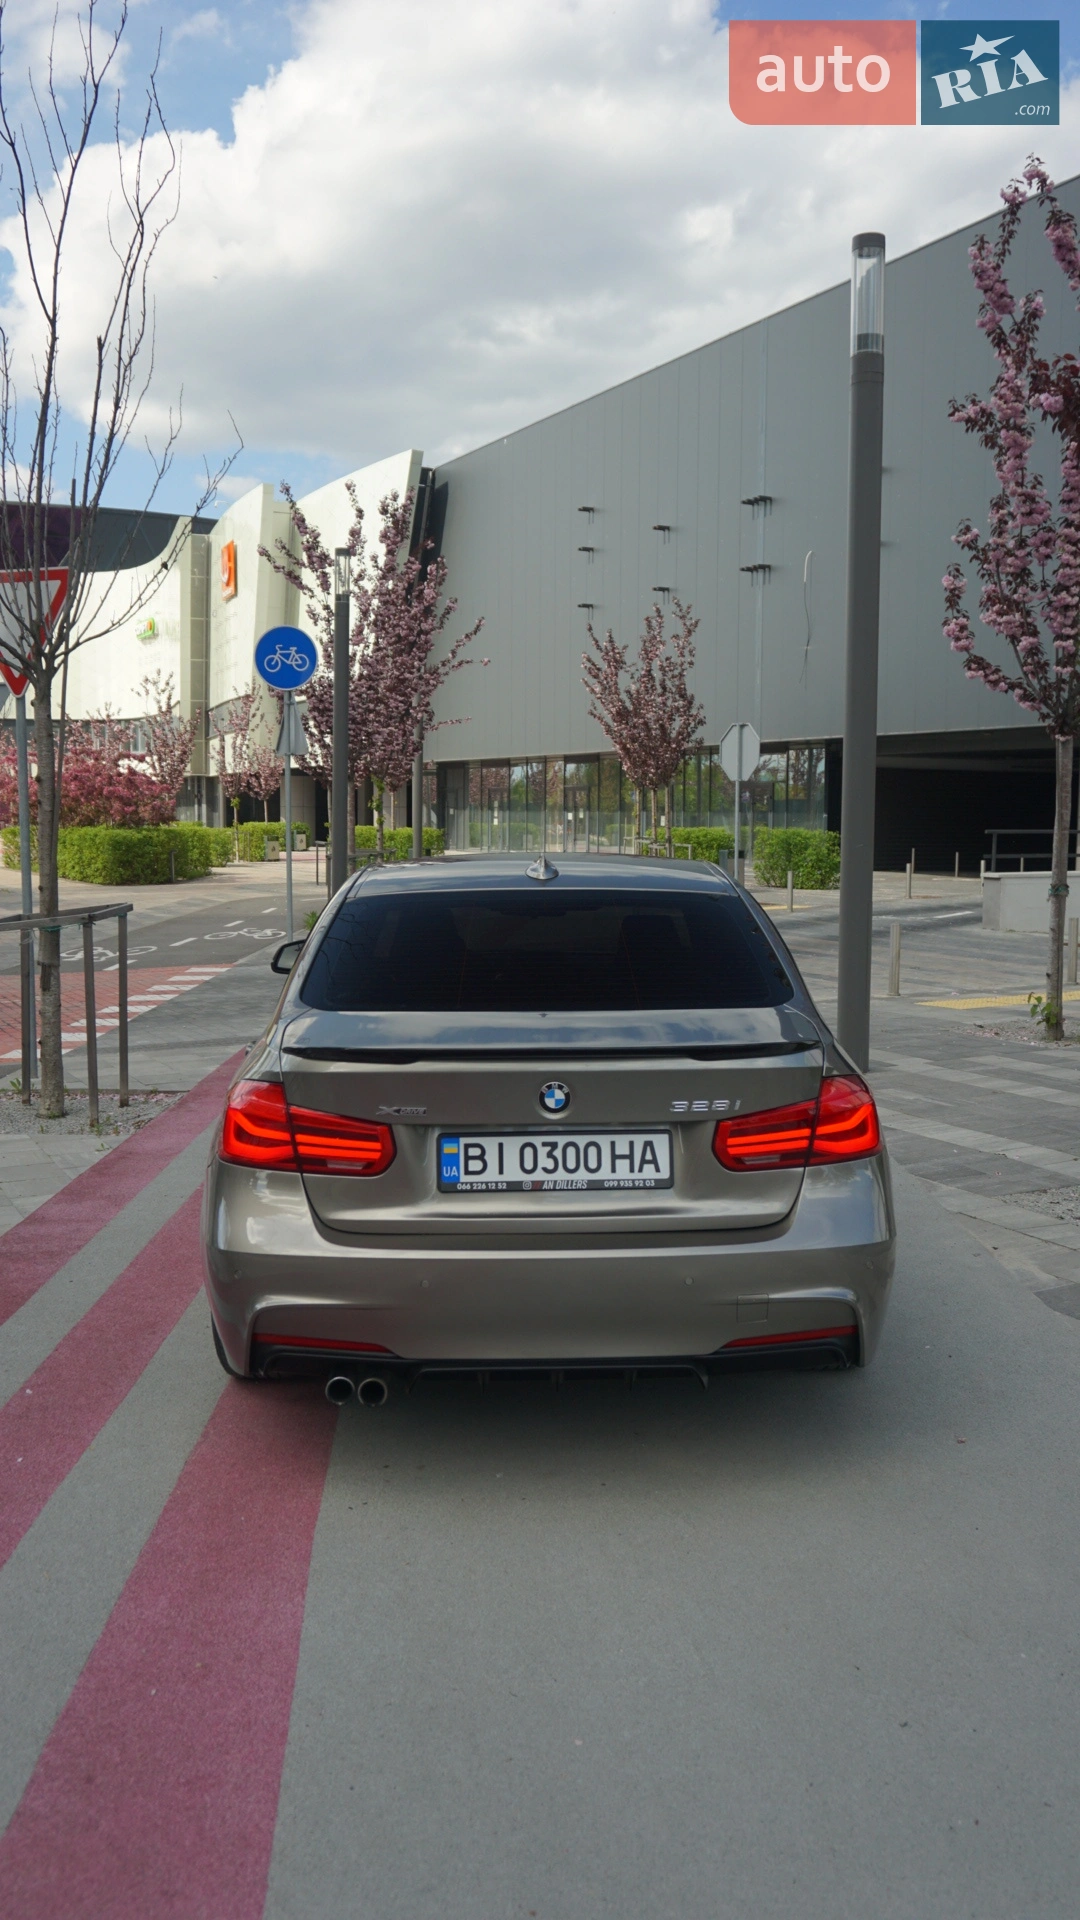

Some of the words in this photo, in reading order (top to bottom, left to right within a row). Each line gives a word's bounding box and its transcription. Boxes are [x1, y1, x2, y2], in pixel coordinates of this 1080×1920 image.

[463, 1142, 504, 1176] BI
[519, 1141, 602, 1175] 0300
[610, 1140, 661, 1174] HA
[443, 1166, 459, 1177] UA
[555, 1179, 588, 1190] DILLERS
[645, 1179, 655, 1187] 03
